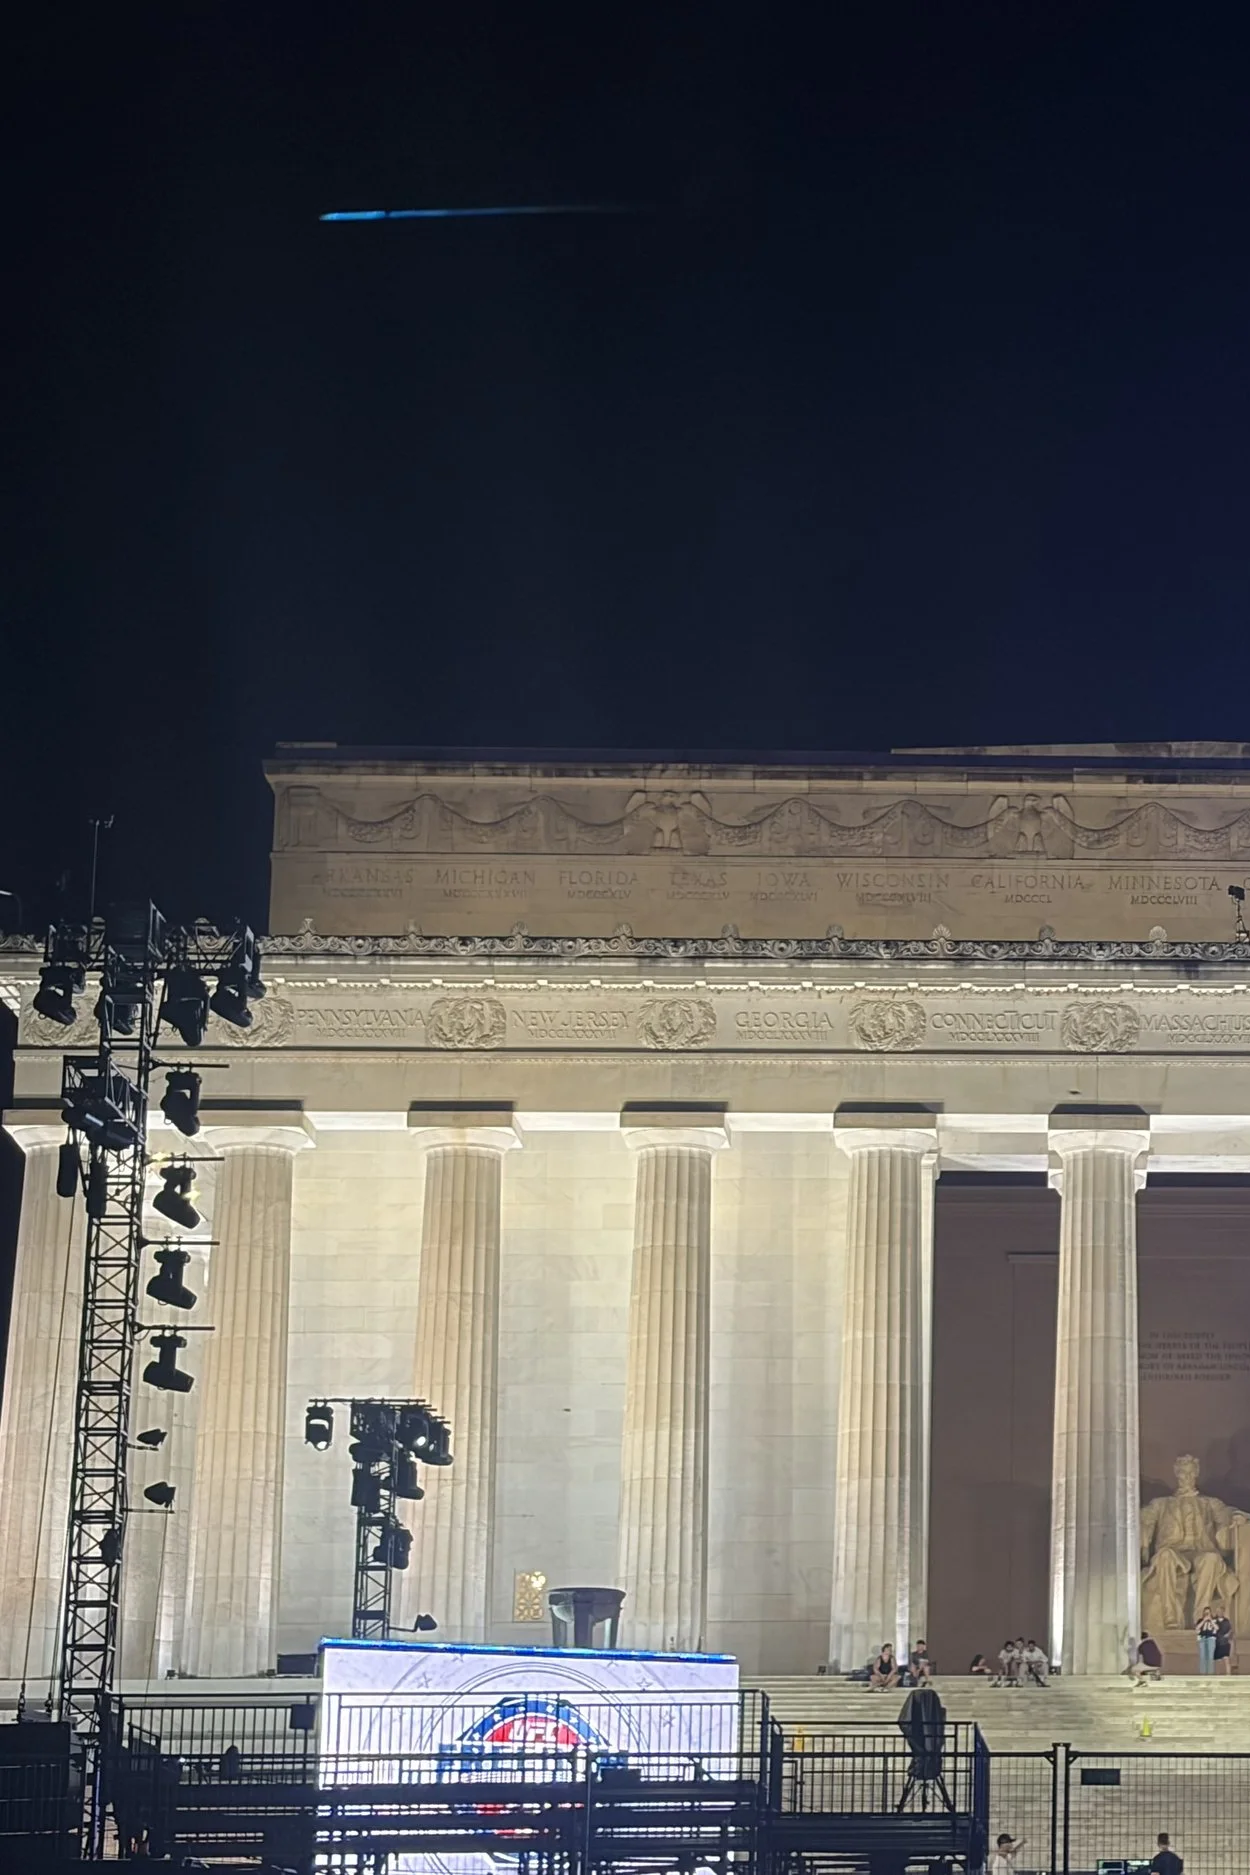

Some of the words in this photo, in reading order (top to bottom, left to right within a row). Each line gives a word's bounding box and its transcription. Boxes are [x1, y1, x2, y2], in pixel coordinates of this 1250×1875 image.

[434, 868, 535, 885] MICHIGAN
[558, 870, 639, 885] FLORIDA
[757, 872, 811, 887] IOWA
[836, 872, 950, 888] WISCONSIN
[970, 873, 1085, 889] CALIFORNIA
[1107, 875, 1222, 891] MINNESOTA
[1004, 894, 1053, 904] MDCCCL
[1130, 895, 1198, 905] MDCCCLVIII
[296, 1008, 427, 1027] PENNSYLVANIA
[511, 1010, 561, 1028] NEW
[560, 1010, 635, 1028] JERSEY
[735, 1011, 835, 1029] GEORGIA
[930, 1009, 1059, 1031] CONNECTICUT
